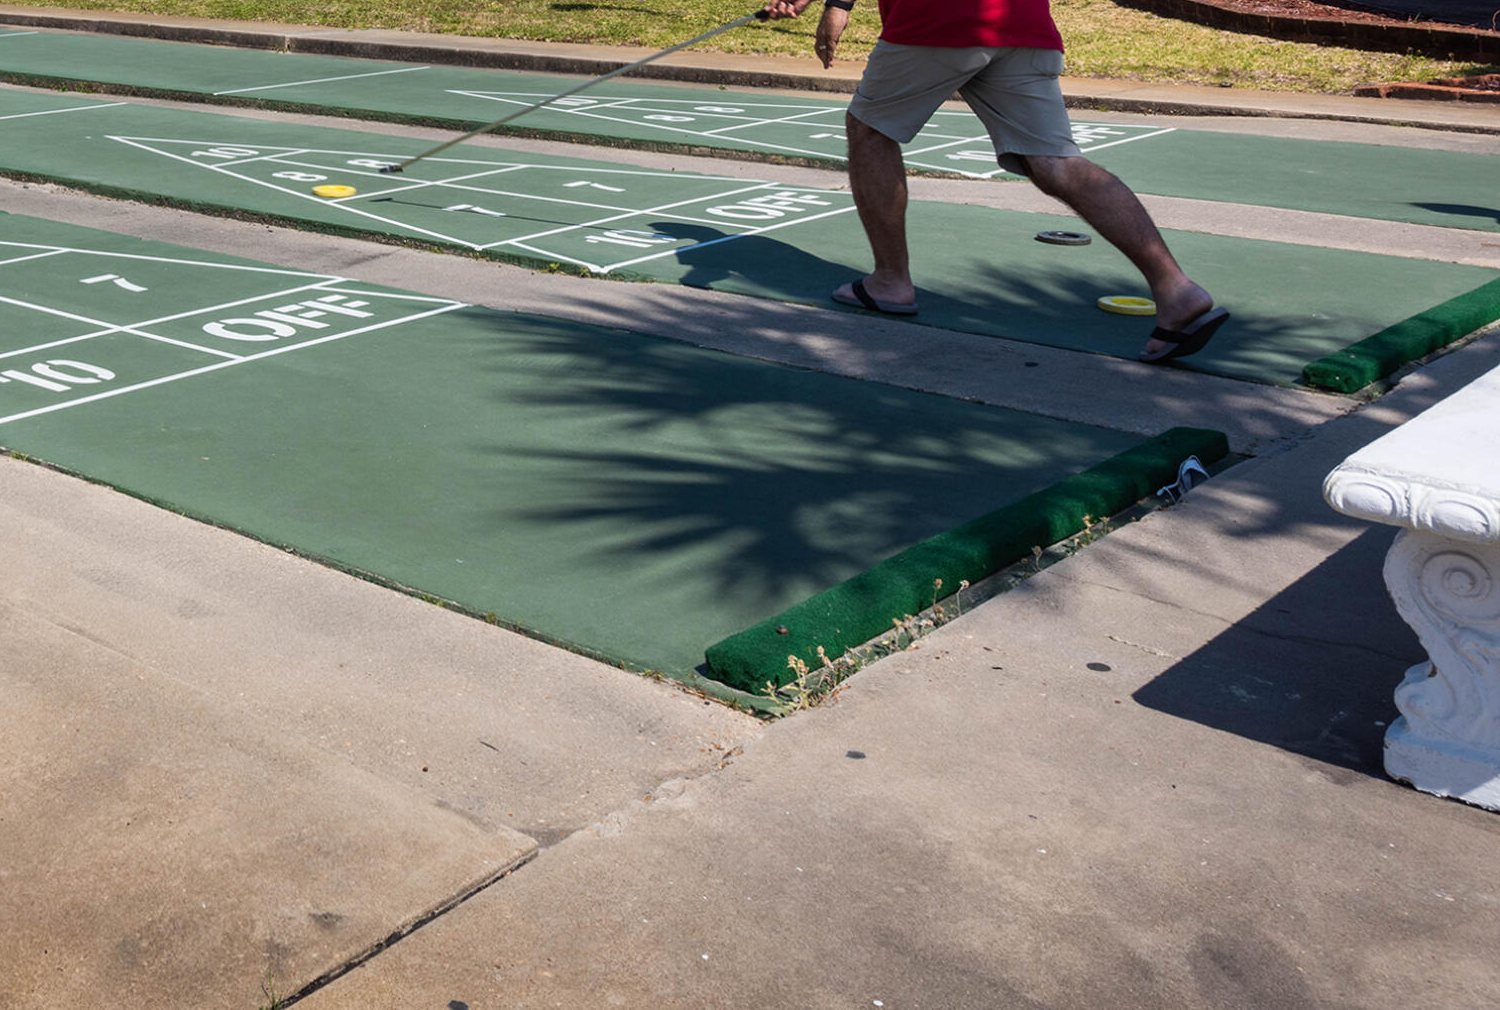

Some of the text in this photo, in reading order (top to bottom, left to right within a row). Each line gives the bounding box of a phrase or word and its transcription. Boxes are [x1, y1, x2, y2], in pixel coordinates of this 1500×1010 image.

[190, 146, 260, 160] 10
[271, 171, 329, 182] 8
[562, 181, 627, 193] 7
[441, 204, 507, 217] 7
[584, 190, 833, 248] 10 OFF
[78, 273, 149, 293] 7
[202, 294, 375, 342] OFF
